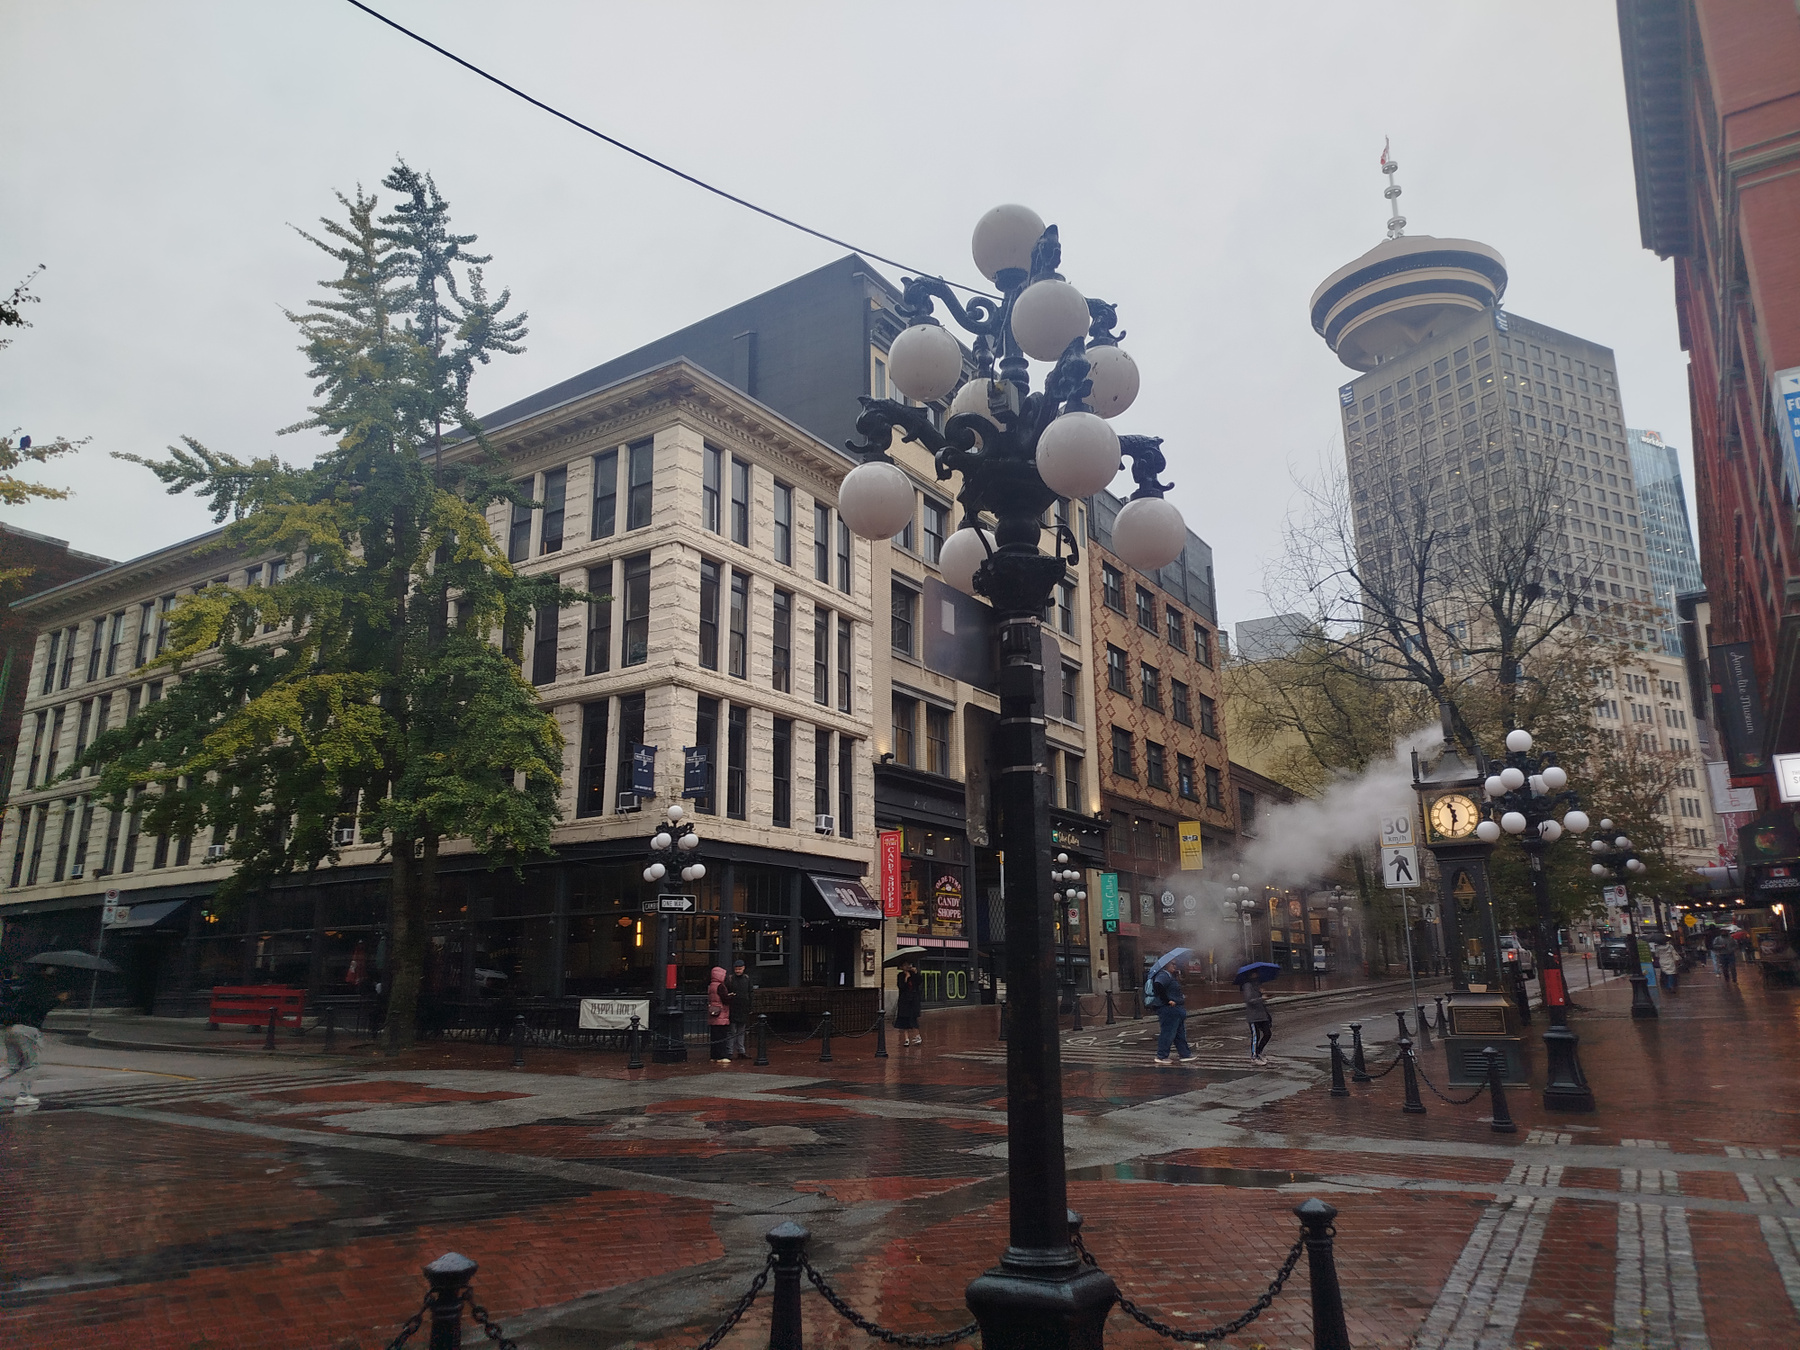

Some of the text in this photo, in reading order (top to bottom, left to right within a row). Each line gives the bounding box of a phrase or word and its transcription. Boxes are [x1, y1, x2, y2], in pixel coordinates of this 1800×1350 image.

[1730, 651, 1754, 734] Ammlite Museum
[1383, 816, 1409, 835] 30
[887, 846, 895, 873] CANDY
[935, 875, 948, 889] OLDE
[834, 887, 863, 907] 302
[937, 896, 961, 907] CANDY
[937, 907, 962, 919] SHOPPE
[590, 1003, 637, 1016] HAPPY HOUR
